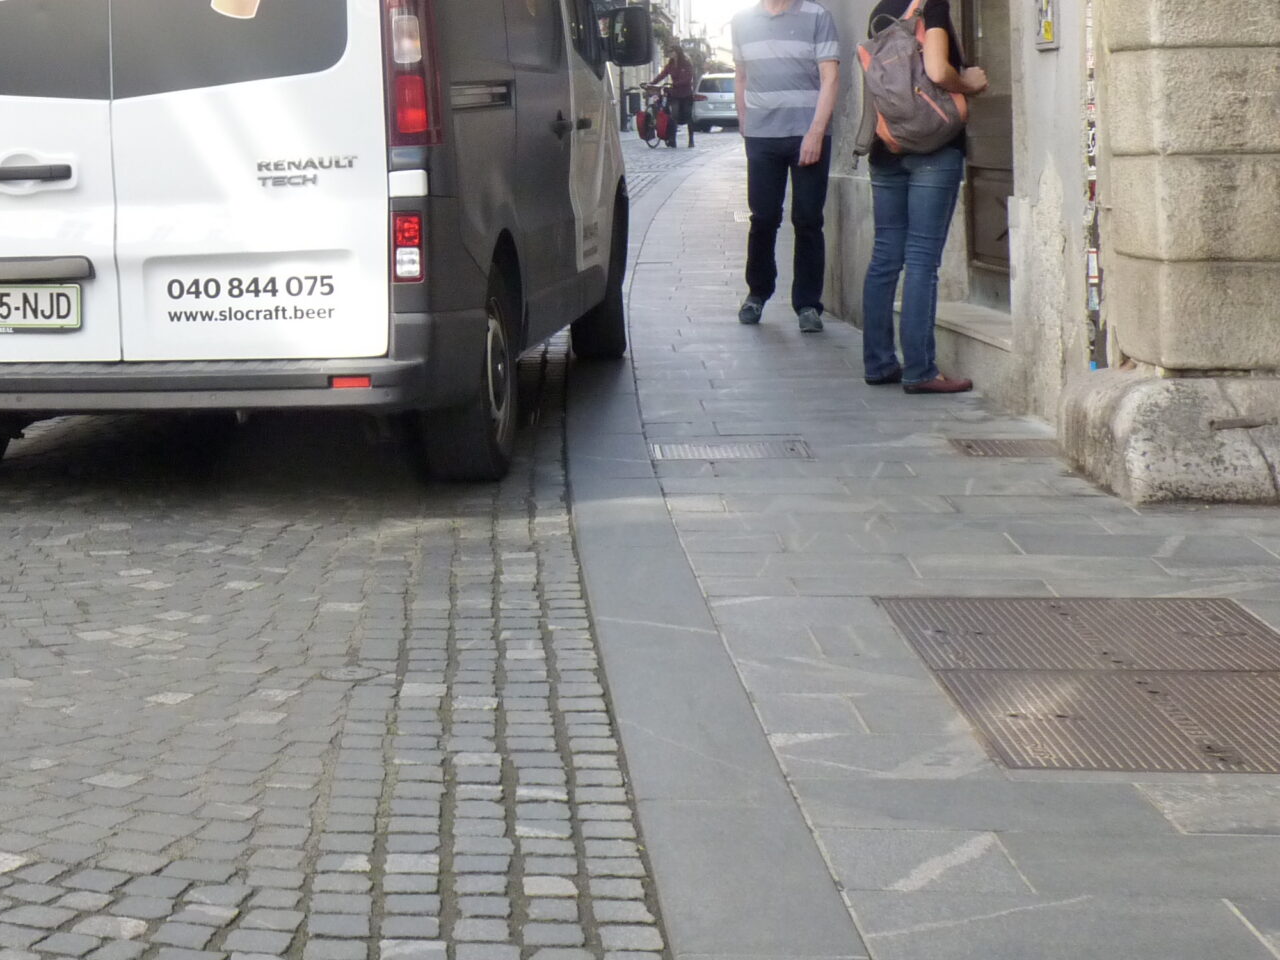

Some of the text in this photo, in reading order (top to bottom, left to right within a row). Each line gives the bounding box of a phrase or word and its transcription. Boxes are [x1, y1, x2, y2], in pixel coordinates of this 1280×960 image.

[257, 156, 358, 172] RENAULT
[257, 174, 317, 187] TECH
[167, 275, 335, 299] 040 844 075
[168, 305, 336, 322] www.slocraft.beer
